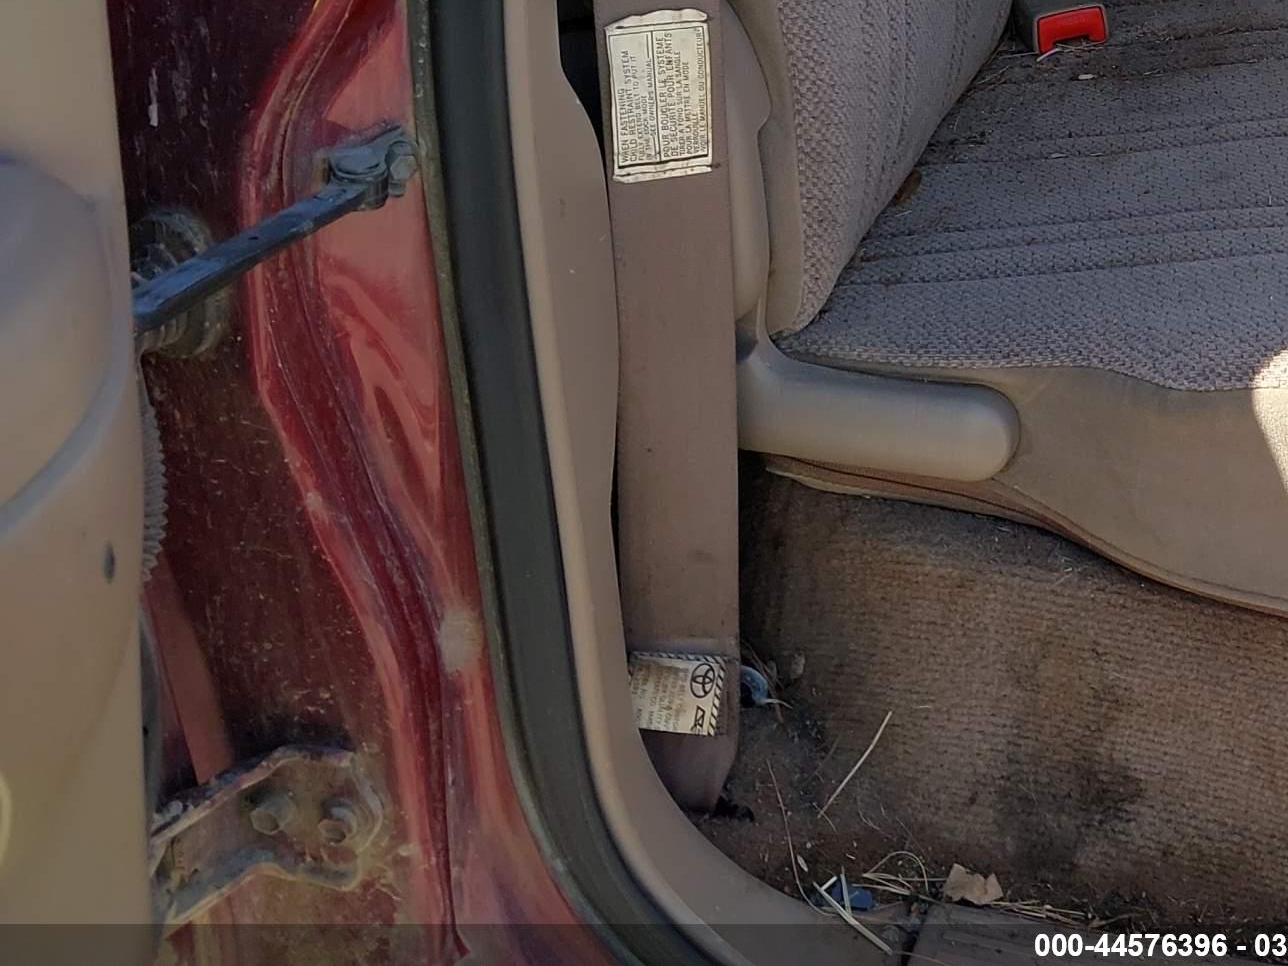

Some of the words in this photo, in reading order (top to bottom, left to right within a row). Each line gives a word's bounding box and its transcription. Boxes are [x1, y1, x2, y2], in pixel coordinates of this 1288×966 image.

[664, 33, 674, 70] ENFANTS
[621, 50, 631, 84] SYSTEM
[633, 81, 639, 89] TO
[659, 79, 666, 88] LE
[667, 74, 675, 98] POUR
[676, 79, 682, 88] LA
[684, 83, 689, 92] EN
[618, 88, 627, 135] FASTENING
[626, 89, 635, 135] RESTRAINT
[686, 125, 691, 133] LA
[621, 139, 629, 163] WHEN
[662, 134, 670, 157] POUR
[671, 145, 678, 156] DE
